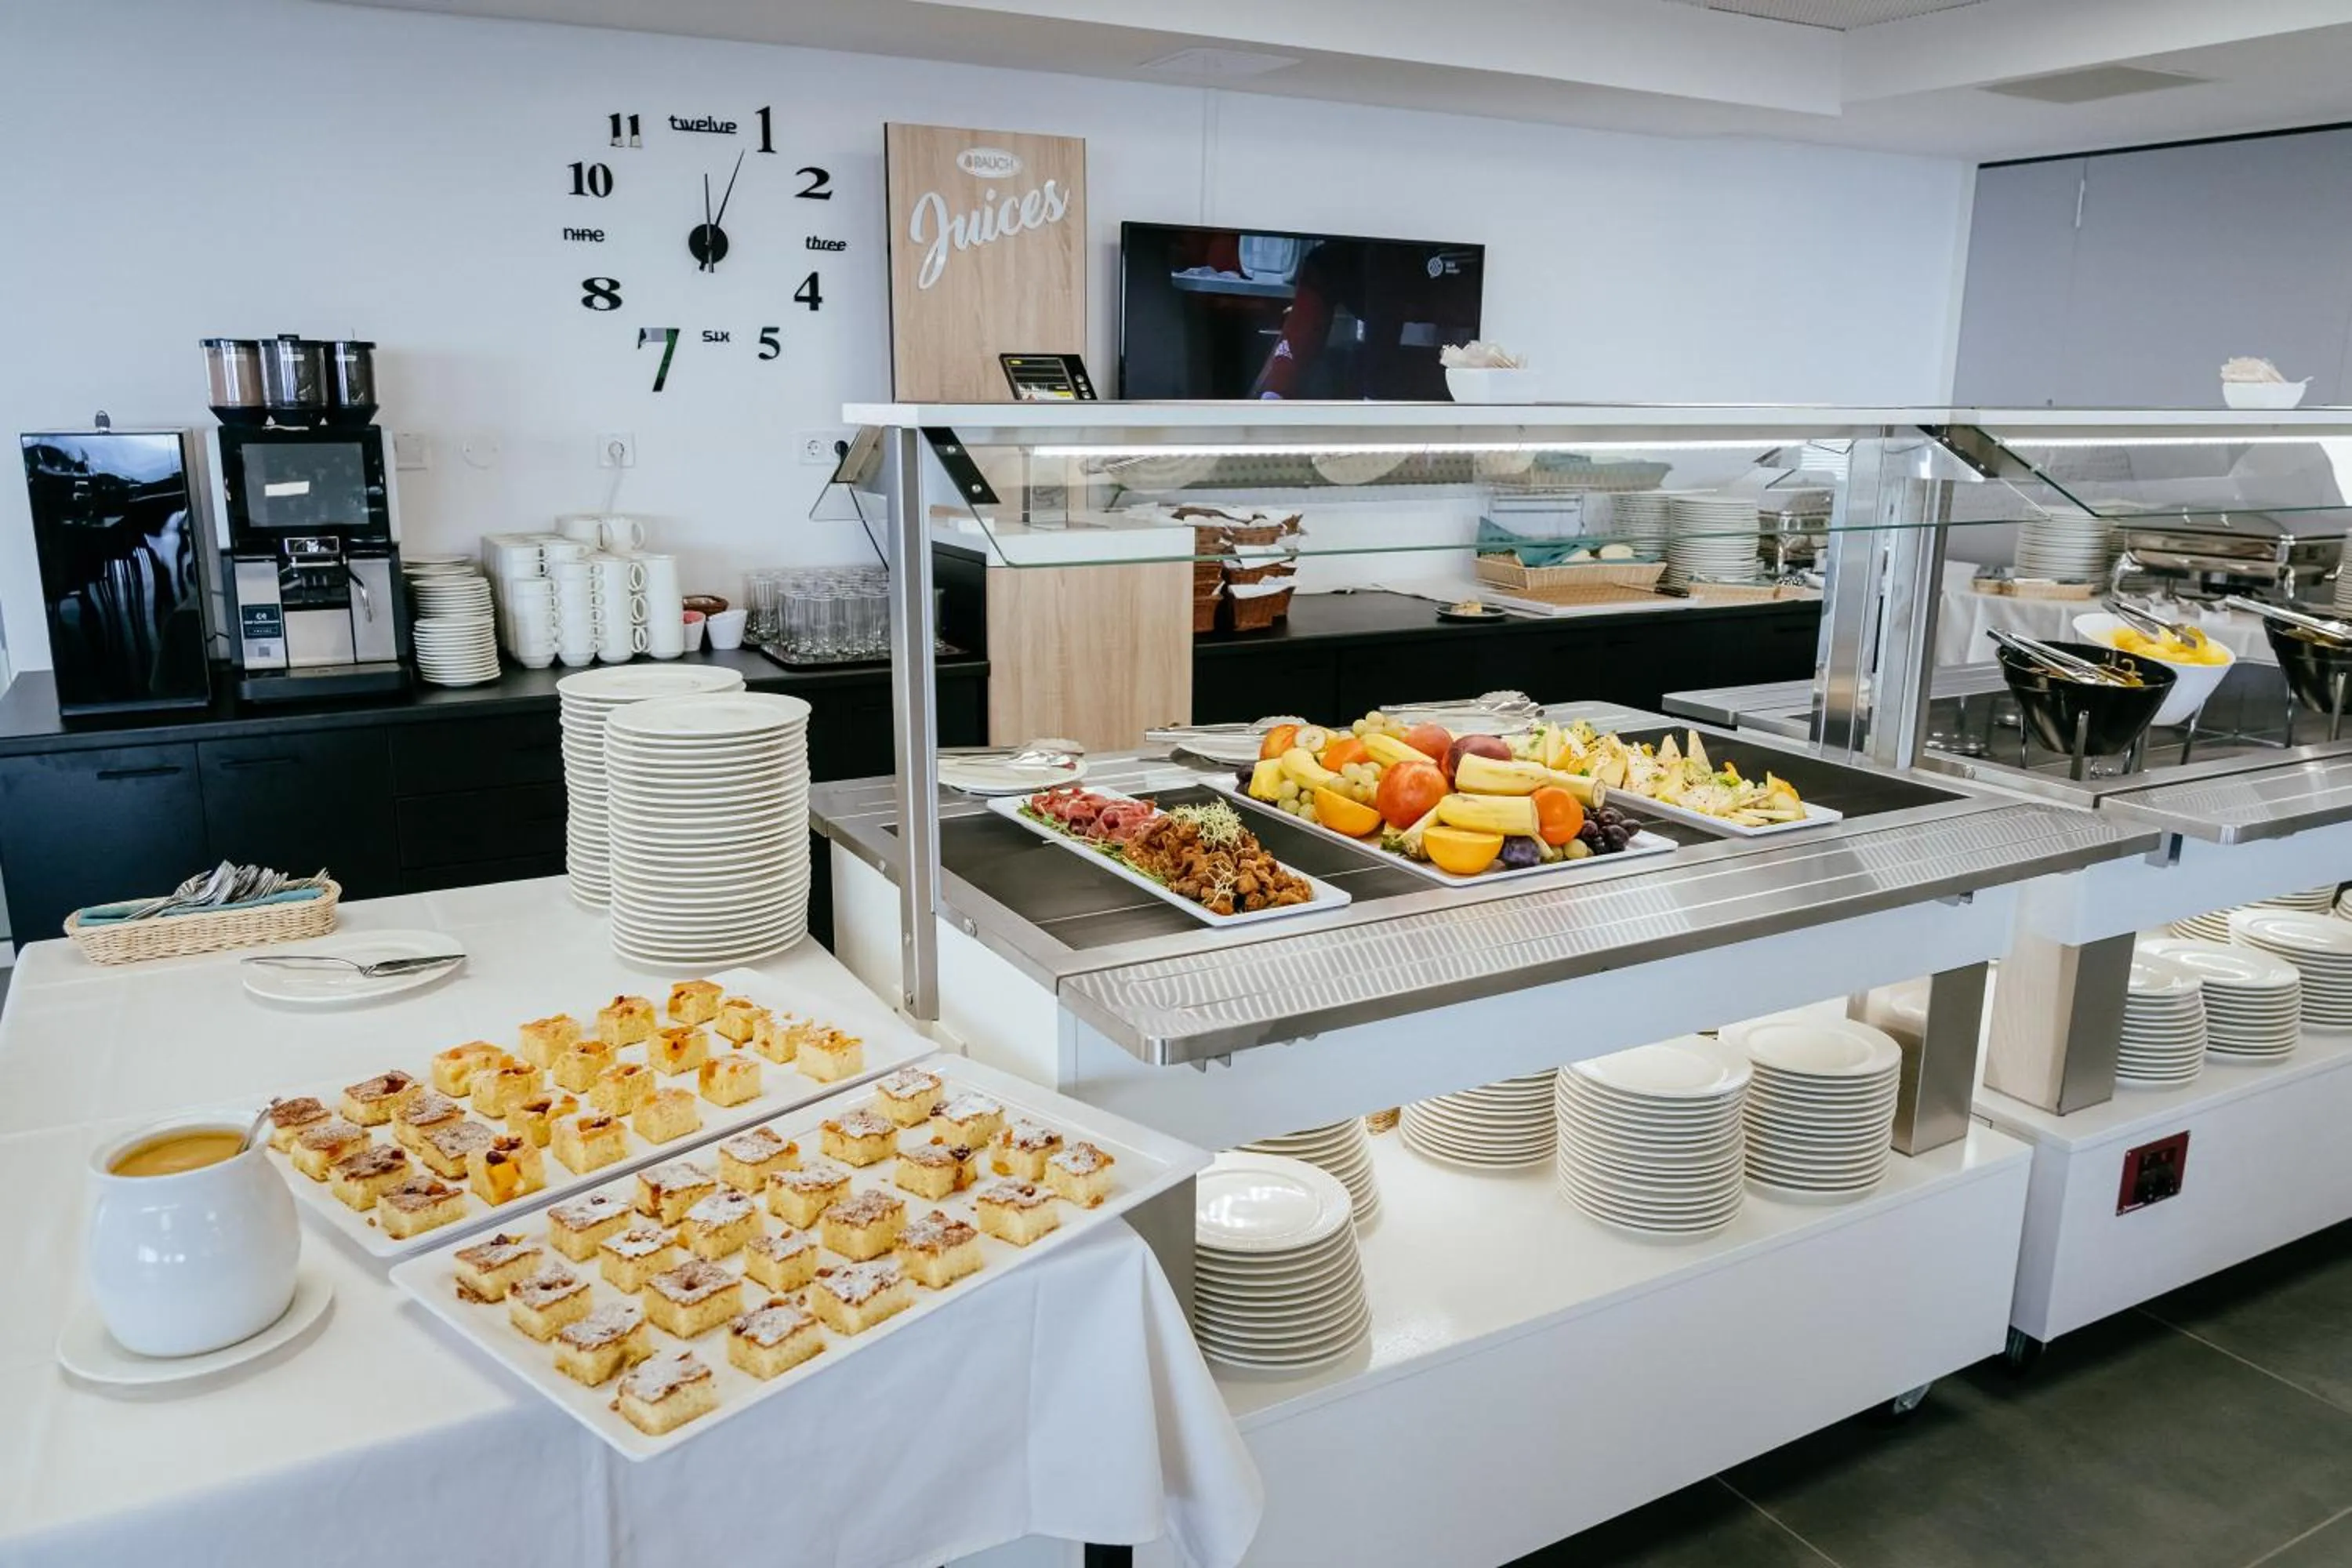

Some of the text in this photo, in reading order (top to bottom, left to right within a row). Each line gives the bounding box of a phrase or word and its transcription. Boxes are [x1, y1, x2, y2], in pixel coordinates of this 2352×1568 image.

[608, 112, 644, 148] 11
[668, 114, 738, 134] twelve
[755, 106, 777, 154] 1
[567, 161, 614, 198] 10
[974, 154, 1014, 170] RAUCH
[794, 166, 833, 201] 2
[563, 227, 605, 243] nine
[806, 235, 848, 252] three
[909, 179, 1071, 291] Juices
[581, 277, 622, 311] 8
[793, 271, 823, 311] 4
[637, 327, 681, 393] 7
[757, 326, 781, 361] 5
